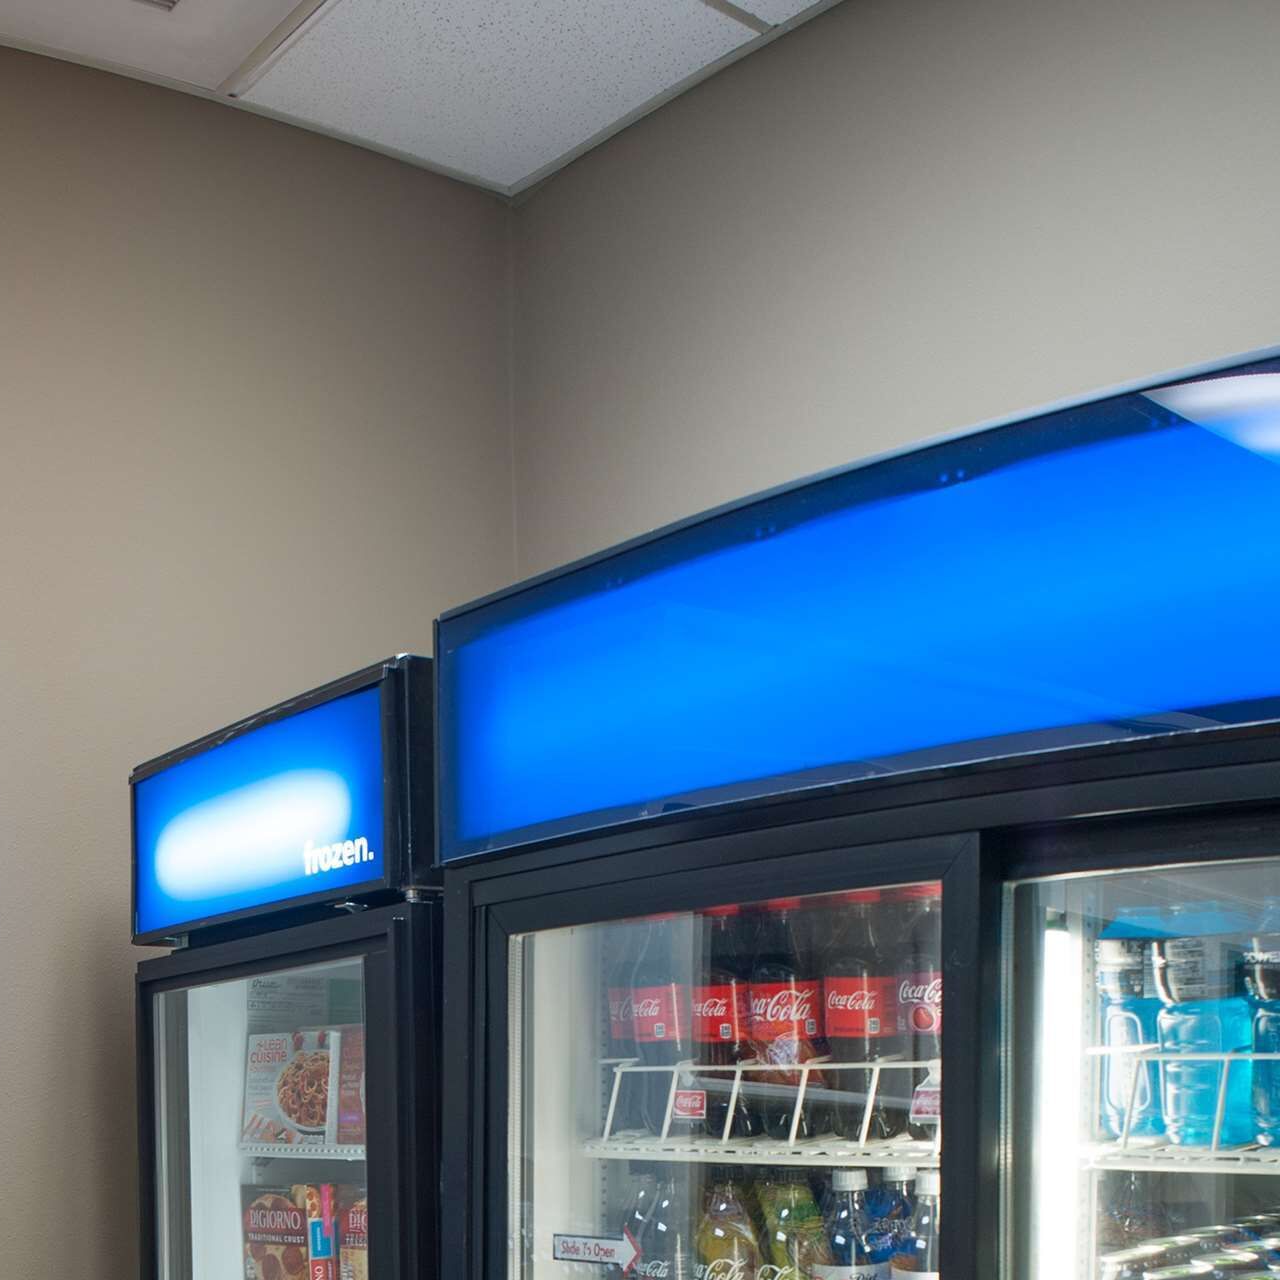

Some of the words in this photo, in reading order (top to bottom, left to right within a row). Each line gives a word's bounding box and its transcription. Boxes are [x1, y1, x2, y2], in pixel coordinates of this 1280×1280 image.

[828, 989, 877, 1011] Coca-Cola
[561, 1240, 582, 1256] Slide
[593, 1243, 616, 1261] Open
